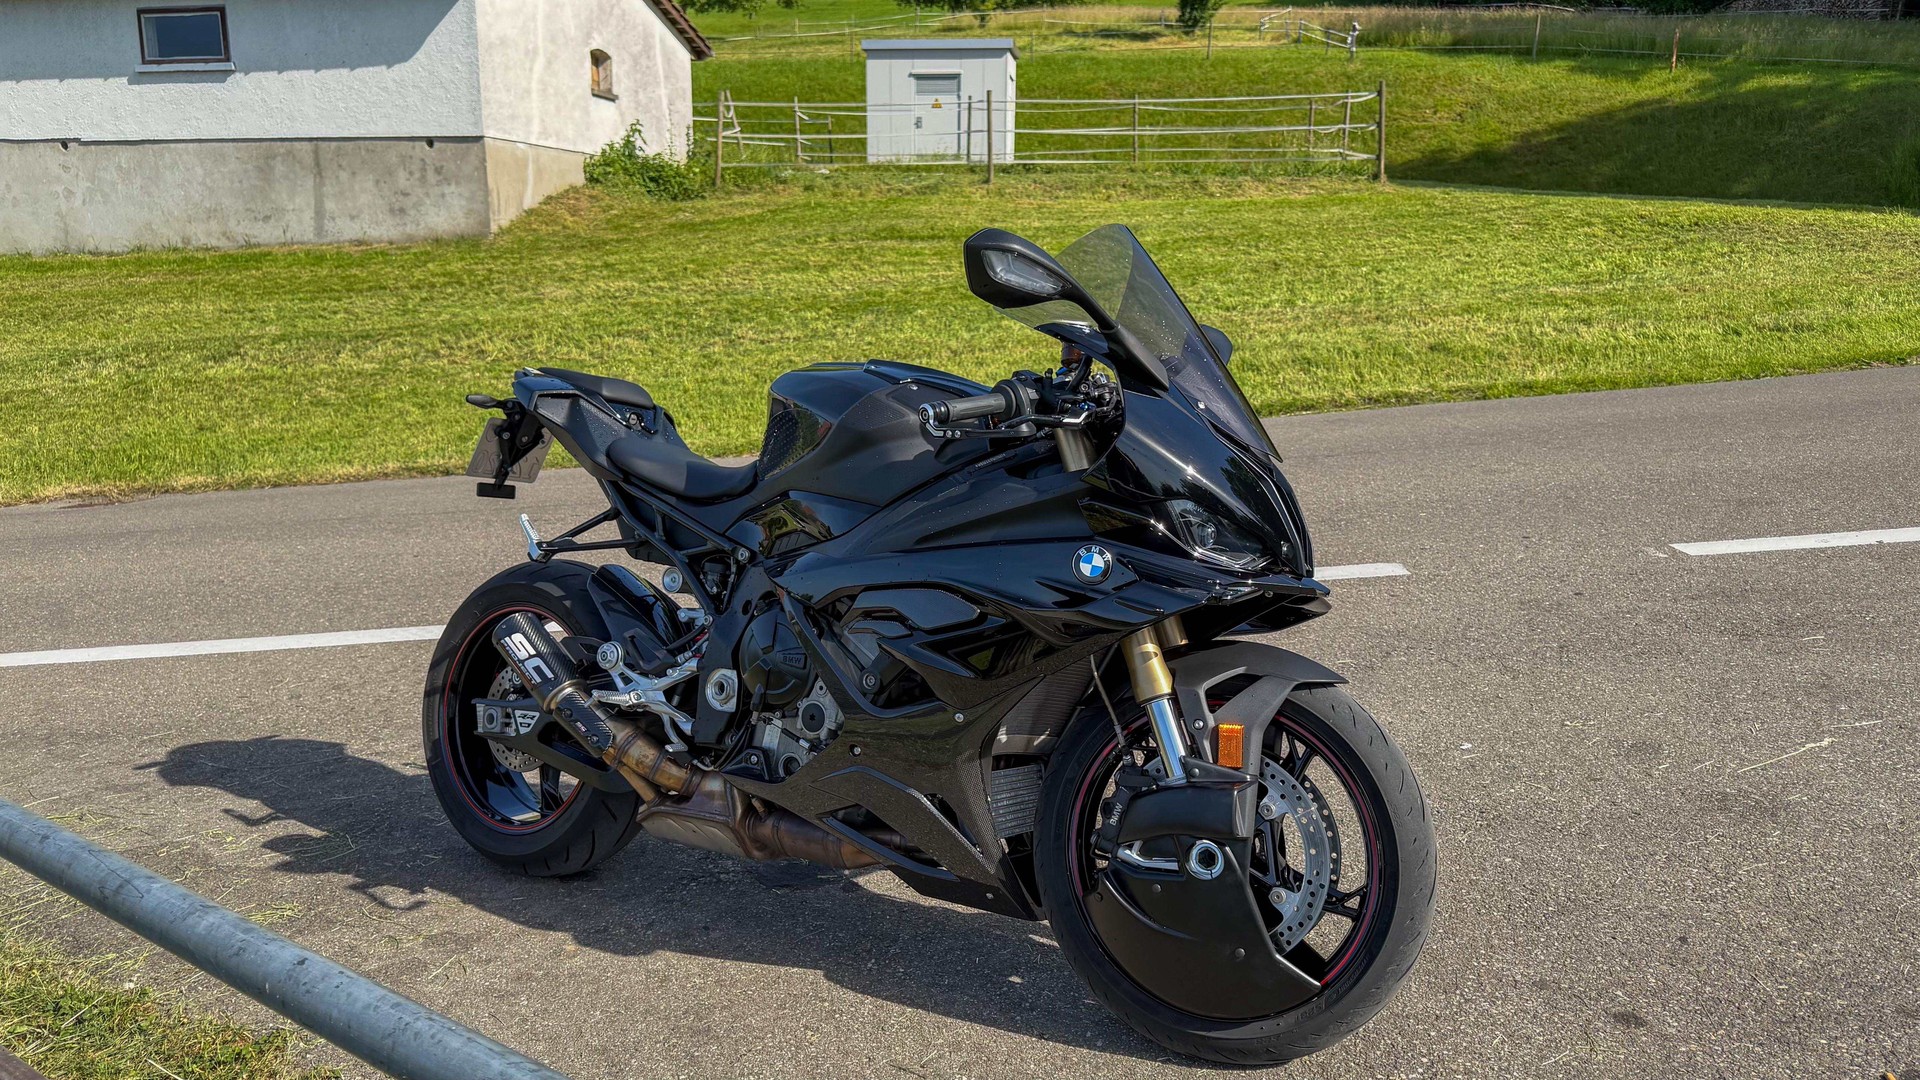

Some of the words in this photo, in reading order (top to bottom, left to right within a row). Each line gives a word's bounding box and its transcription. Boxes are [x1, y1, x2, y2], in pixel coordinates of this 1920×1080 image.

[1078, 545, 1110, 562] BMW
[504, 632, 555, 683] SC
[783, 655, 802, 665] BMW
[1109, 802, 1123, 826] BMW
